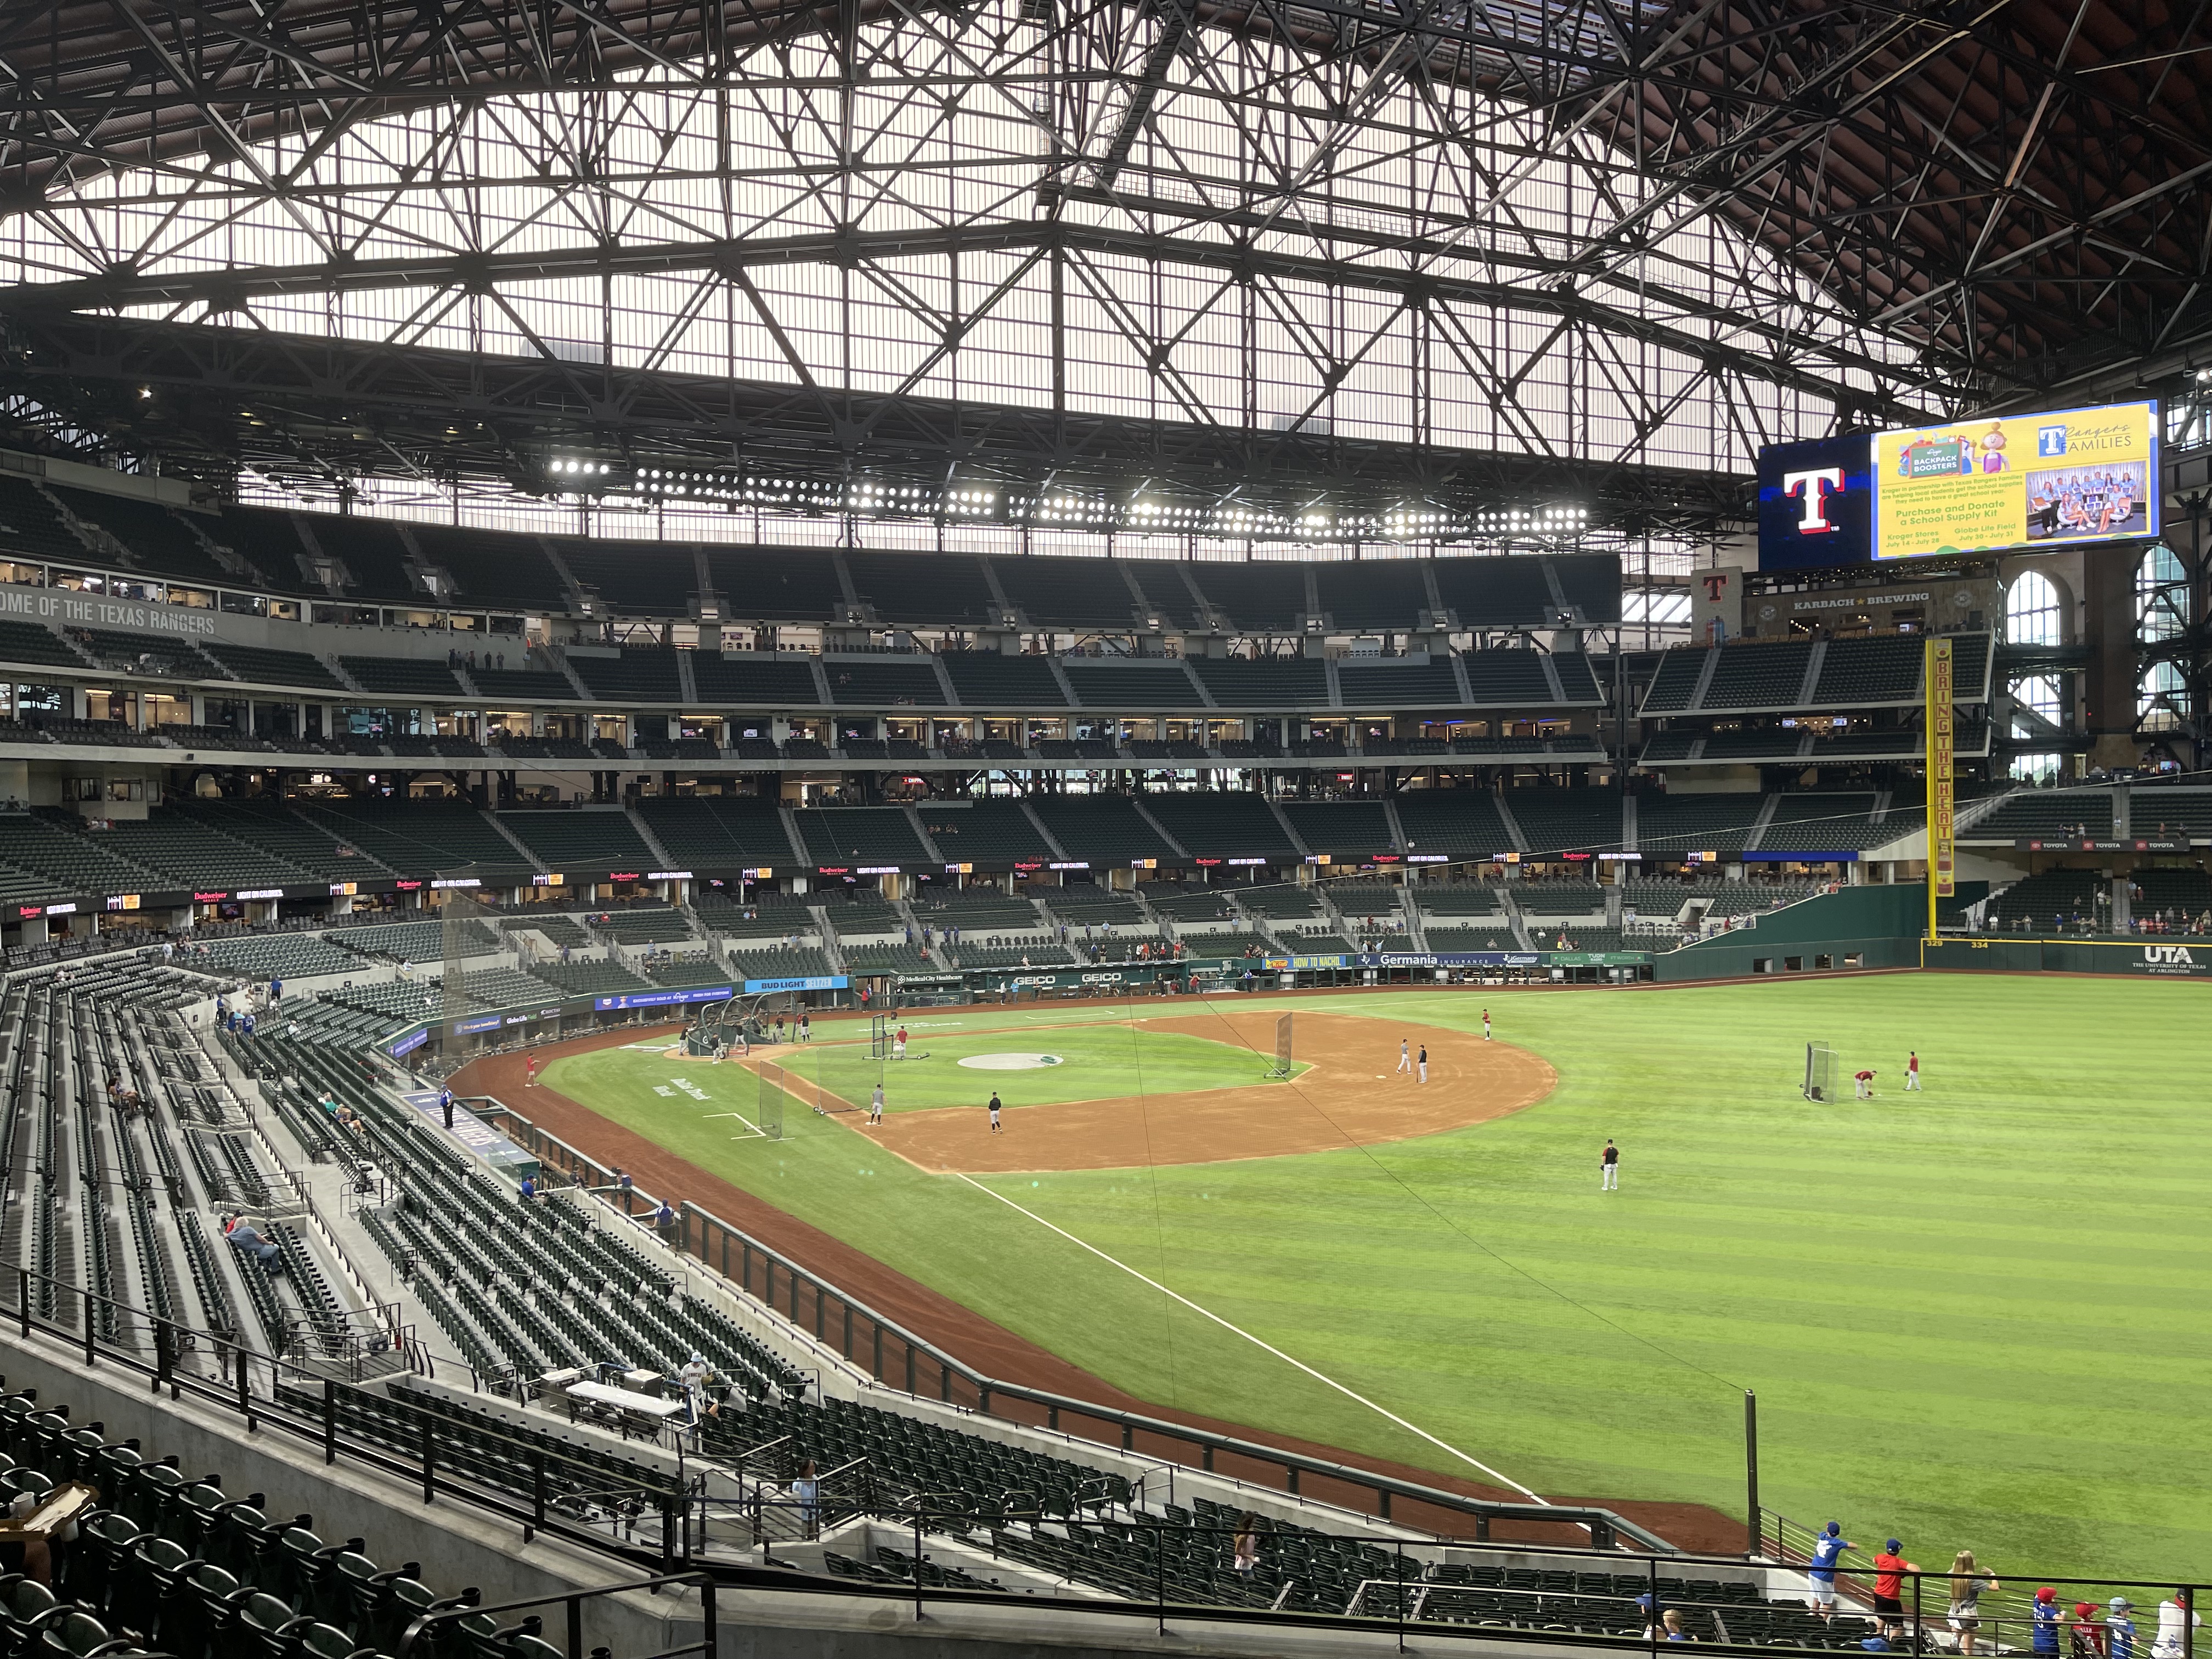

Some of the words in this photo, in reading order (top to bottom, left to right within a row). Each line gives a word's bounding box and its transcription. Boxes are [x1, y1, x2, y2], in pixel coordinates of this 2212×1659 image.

[2061, 436, 2131, 453] FAMILIES
[1914, 455, 1957, 465] BACKPACK
[1914, 462, 1957, 472] BOOSTERS
[1909, 483, 1941, 491] partnership
[1784, 467, 1845, 535] T
[1896, 507, 1942, 518] Purchase
[1945, 504, 1965, 513] and
[1968, 500, 2005, 511] Donate
[1910, 515, 1944, 525] School
[1947, 511, 1981, 522] Supply
[1984, 509, 1997, 518] Kit
[1703, 575, 1728, 602] T
[1794, 598, 1855, 610] KARBACH
[1867, 592, 1930, 605] BREWING
[39, 596, 59, 617] OF
[64, 599, 93, 621] THE
[98, 603, 145, 627] TEXAS
[150, 610, 215, 634] RANGERS
[1938, 661, 1949, 731] BRING
[1938, 737, 1949, 777] THE
[1939, 782, 1950, 838] HEAT
[194, 891, 228, 900] Budweiser
[236, 891, 251, 900] LIGHT
[252, 891, 259, 899] ON
[1380, 955, 1438, 965] Germania
[2145, 946, 2193, 963] UTA
[1293, 957, 1309, 968] HOW
[1310, 957, 1318, 967] TO
[1319, 956, 1341, 966] NACHO.
[806, 978, 832, 989] SELTZER
[1016, 975, 1056, 985] GEICO
[1082, 973, 1122, 983] GEICO
[673, 992, 689, 1002] Kroger
